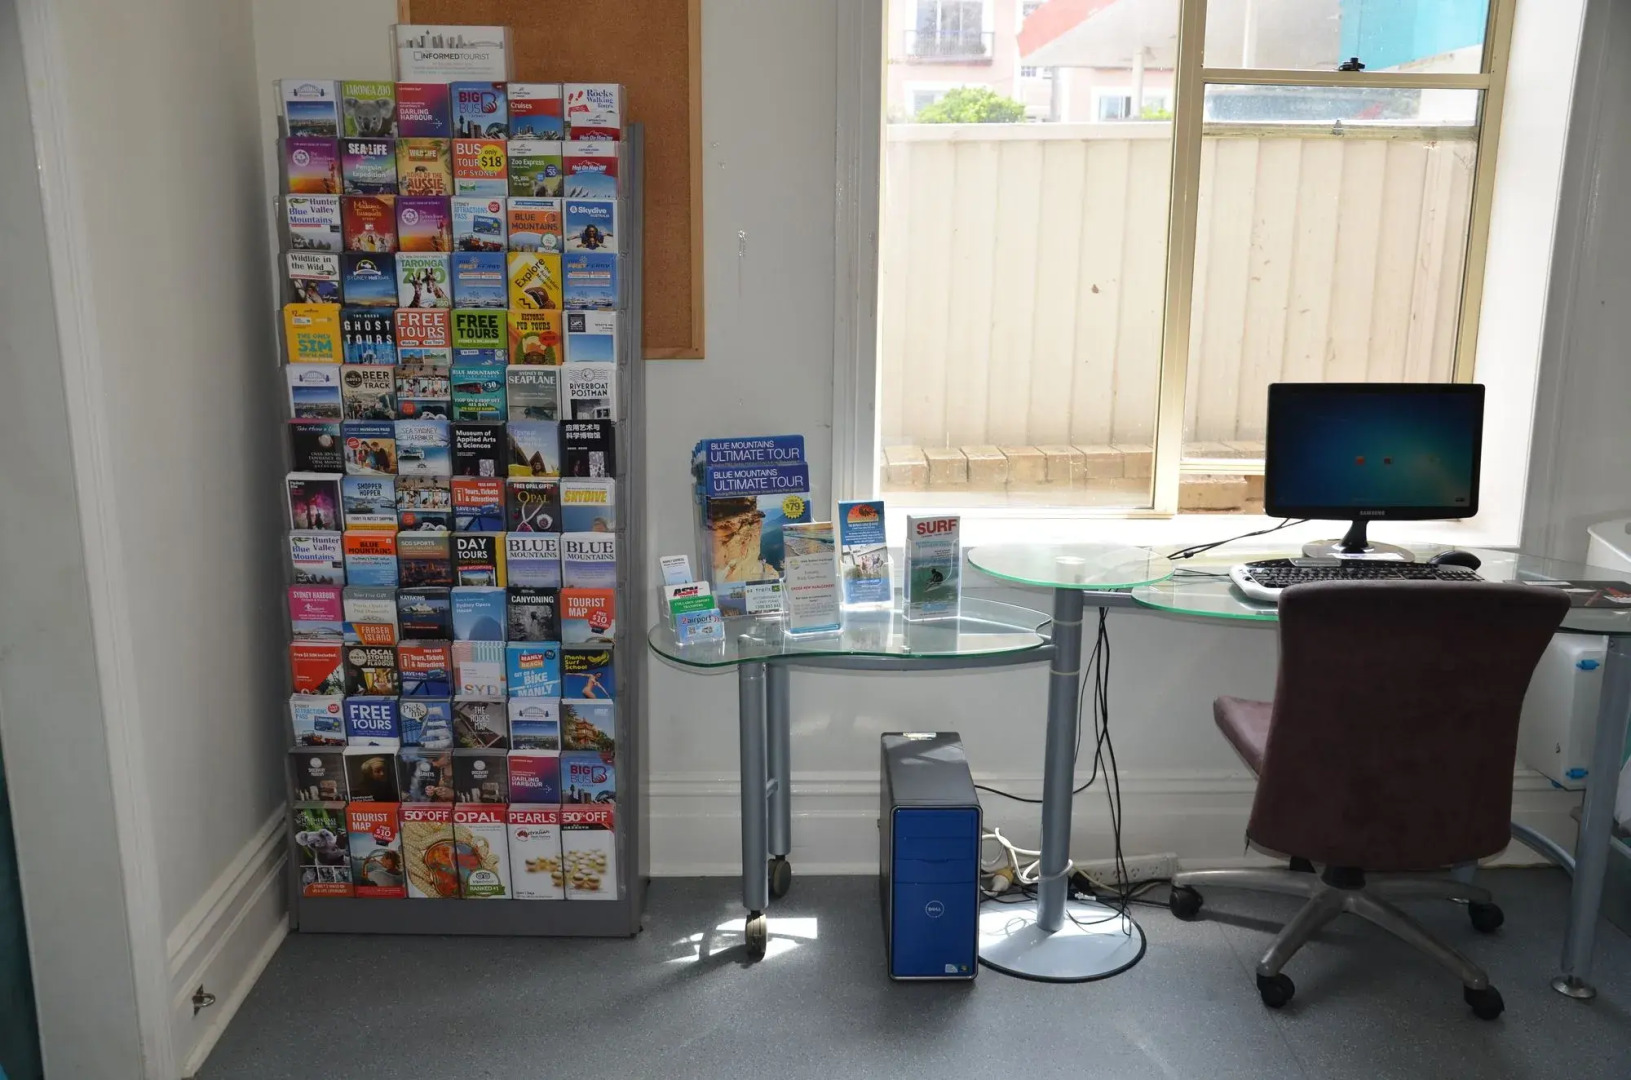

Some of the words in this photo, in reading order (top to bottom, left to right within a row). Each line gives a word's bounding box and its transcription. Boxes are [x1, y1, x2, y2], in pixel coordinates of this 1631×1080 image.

[346, 85, 376, 95] TARONGA
[377, 85, 390, 96] ZOO
[459, 92, 480, 102] BIG
[459, 104, 480, 113] BUS
[348, 143, 366, 155] SEA
[456, 144, 481, 155] BUS
[481, 157, 501, 167] $18
[407, 178, 443, 189] AUSSIE
[310, 206, 334, 214] Valley
[514, 258, 545, 288] Explore
[397, 313, 444, 326] FREE
[457, 315, 498, 328] FREE
[344, 320, 391, 331] GHOST
[531, 322, 550, 330] TOURS
[399, 327, 444, 337] TOURS
[458, 328, 499, 338] TOURS
[346, 335, 392, 345] TOURS
[299, 340, 333, 352] SIM
[509, 376, 555, 384] SEAPLANE
[731, 441, 774, 449] MOUNTAINS
[711, 449, 764, 462] ULTIMATE
[767, 448, 800, 459] TOUR
[734, 468, 777, 478] MOUNTAINS
[714, 478, 768, 491] ULTIMATE
[770, 475, 803, 488] TOUR
[564, 491, 607, 503] SKYDIVE
[785, 502, 800, 511] $79
[917, 519, 957, 535] SURF
[457, 539, 486, 549] DAY
[509, 540, 556, 551] BLUE
[566, 541, 614, 553] BLUE
[568, 598, 605, 607] TOURIST
[568, 608, 588, 616] MAP
[592, 615, 607, 623] $10
[524, 672, 548, 684] BIKE
[465, 684, 498, 695] SYD
[518, 685, 552, 697] MANLY
[350, 705, 391, 719] FREE
[402, 703, 420, 712] Pick
[474, 706, 485, 715] THE
[352, 720, 392, 730] TOURS
[570, 765, 590, 774] BIG
[570, 775, 591, 783] BUS
[352, 813, 387, 822] TOURIST
[428, 811, 449, 821] OFF
[454, 812, 500, 823] OPAL
[509, 813, 556, 823] PEARLS
[586, 812, 607, 822] OFF
[352, 822, 371, 830] MAP
